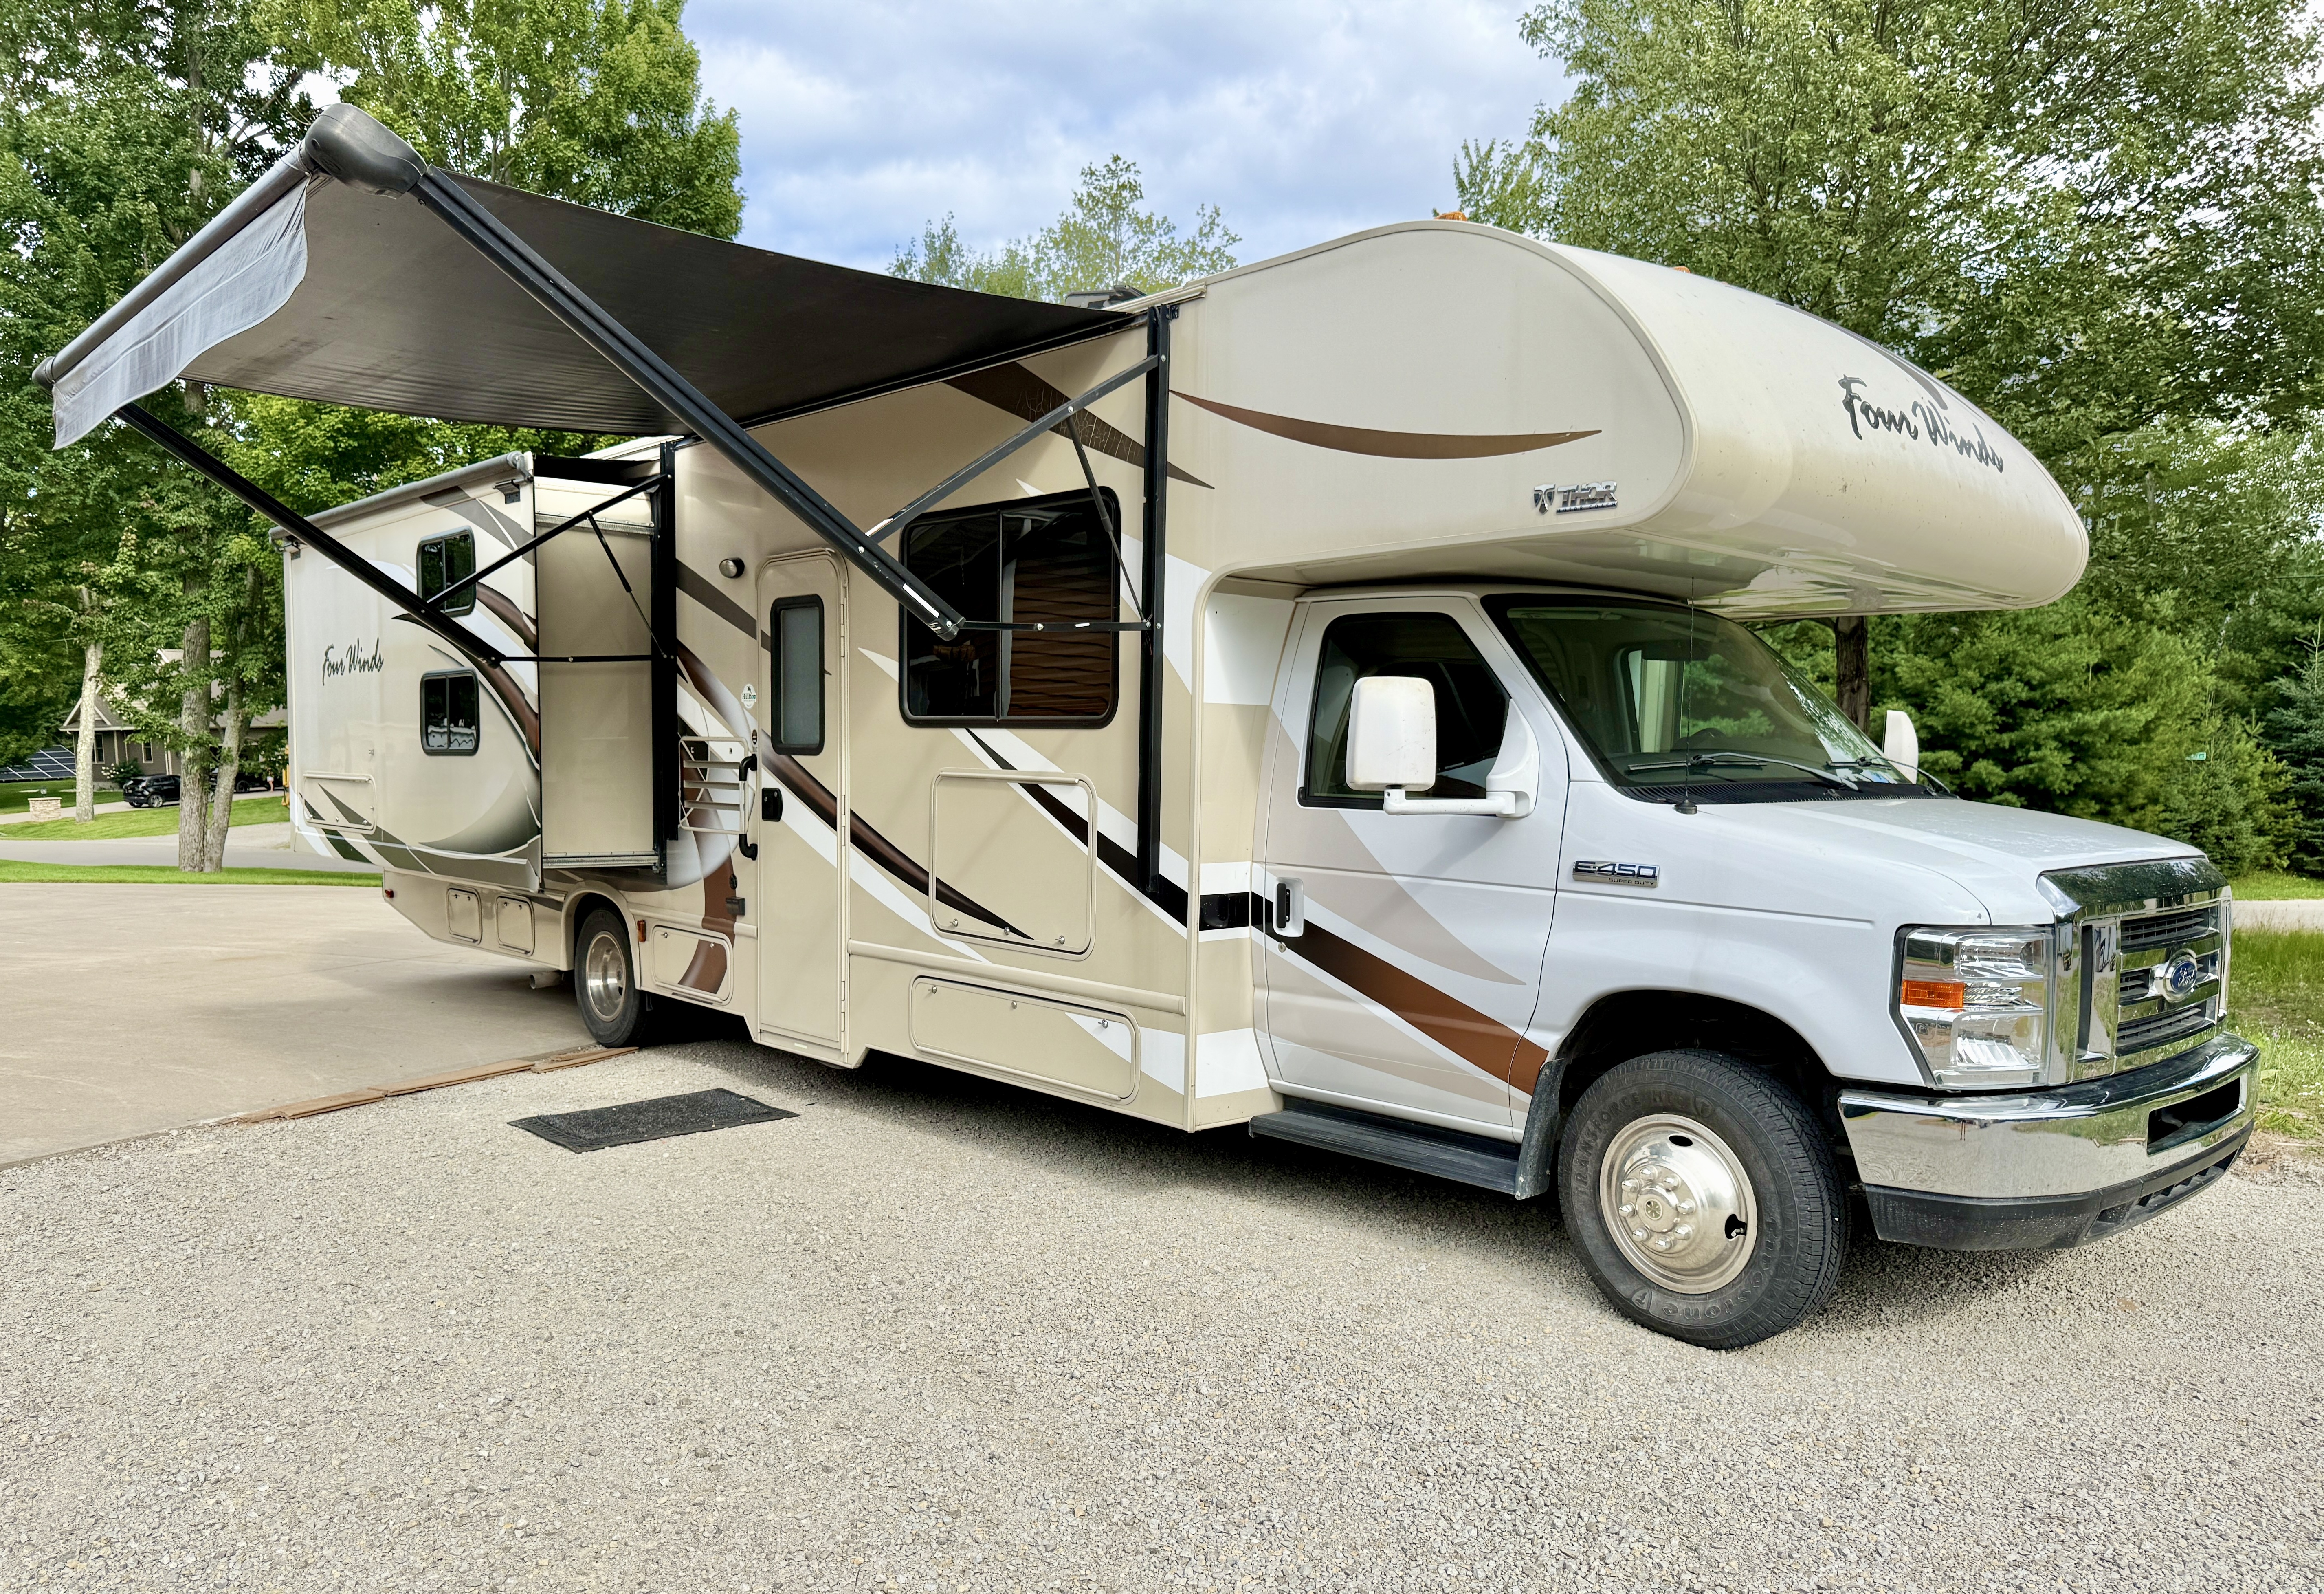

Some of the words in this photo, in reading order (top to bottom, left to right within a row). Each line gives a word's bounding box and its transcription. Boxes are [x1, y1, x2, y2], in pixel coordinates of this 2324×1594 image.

[1838, 374, 1918, 440] Four
[1911, 400, 2004, 473] Winds
[1557, 481, 1618, 507] THOR
[322, 643, 345, 686] Four
[346, 637, 384, 674] Winds
[2178, 967, 2195, 987] Ford
[1662, 1216, 1778, 1320] Firestone
